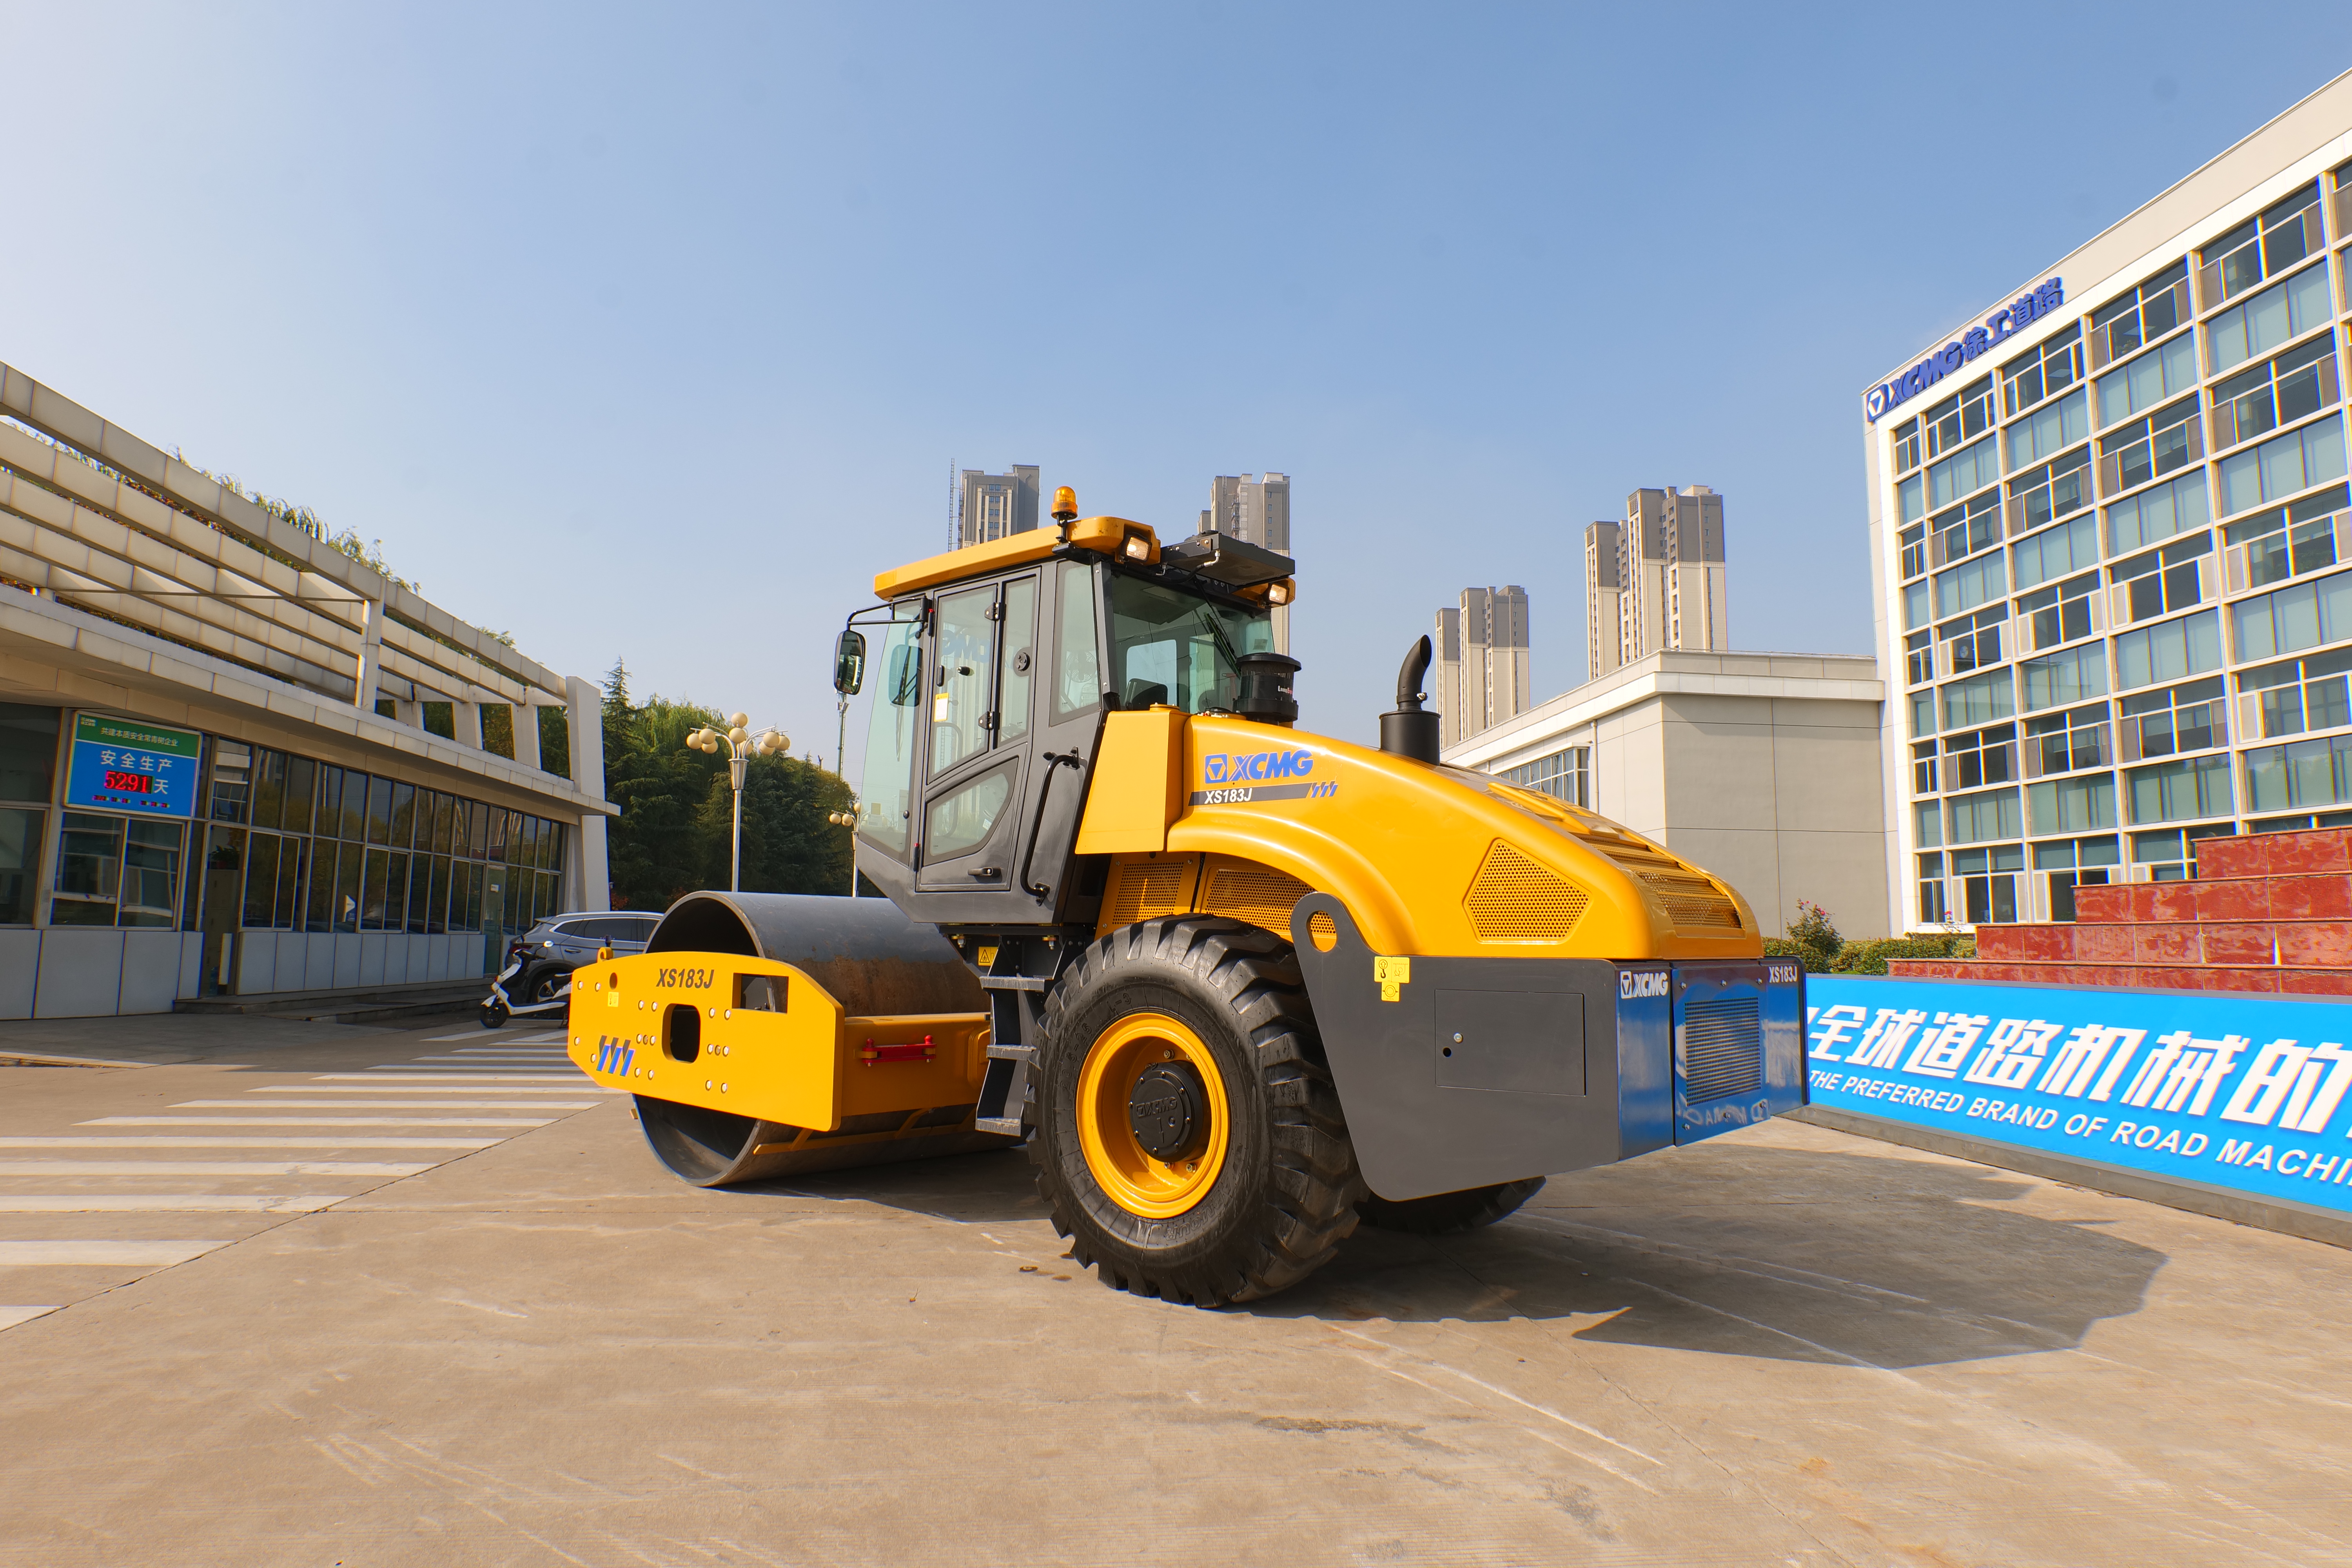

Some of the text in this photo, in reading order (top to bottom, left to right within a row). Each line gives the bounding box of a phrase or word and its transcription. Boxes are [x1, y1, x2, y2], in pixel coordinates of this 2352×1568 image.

[1887, 277, 2065, 410] XCMG 徐工道路
[100, 727, 178, 747] 共建本质安全常青树企业
[100, 750, 172, 772] 安全生产
[1227, 749, 1314, 781] XCMG
[104, 771, 169, 795] 5291 天
[1205, 788, 1252, 804] XS183J
[656, 968, 715, 989] XS183J
[1632, 972, 1668, 997] XCMG
[1768, 966, 1797, 983] XS183J
[1808, 1005, 2352, 1138] 全球道路机械的
[1146, 1096, 1178, 1116] XCMG
[1809, 1070, 2352, 1186] THE PREFERRED BRAND OF ROAD MACHI
